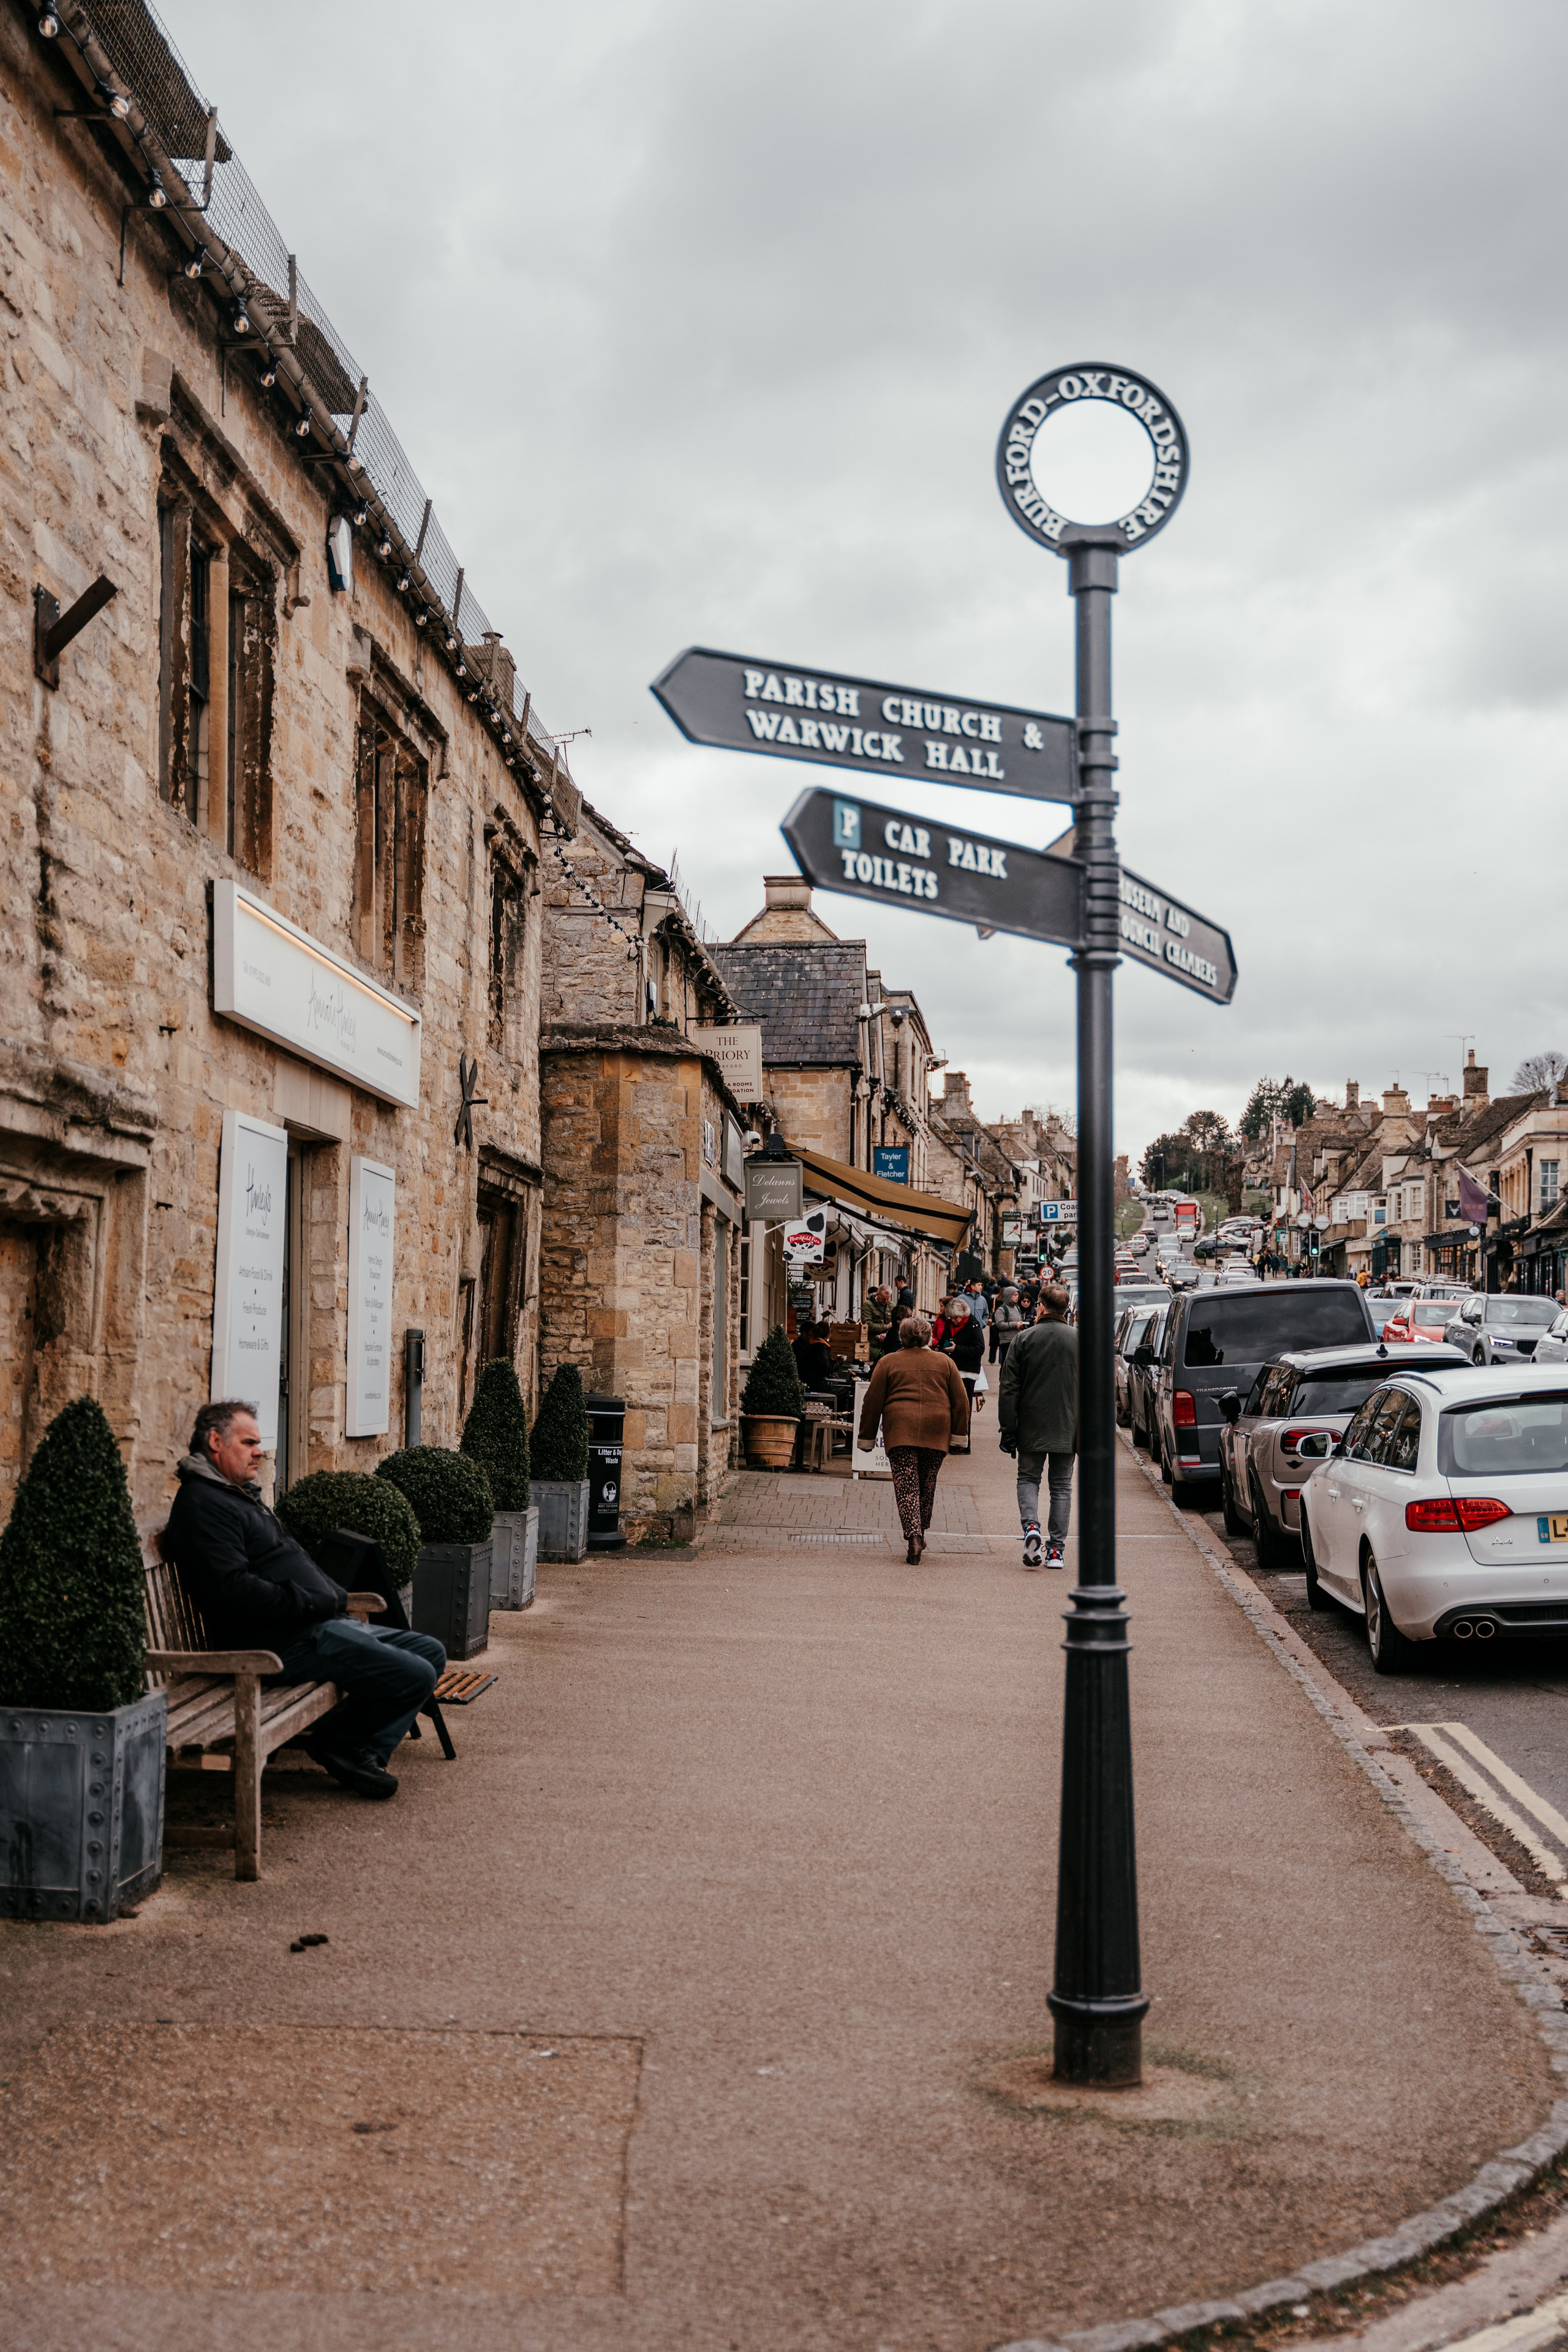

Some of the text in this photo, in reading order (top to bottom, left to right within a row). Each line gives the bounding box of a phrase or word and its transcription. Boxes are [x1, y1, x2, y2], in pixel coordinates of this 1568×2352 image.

[744, 669, 1045, 750] PARISH CHURCH &
[745, 709, 1005, 780] WARWICK HALL
[841, 807, 1008, 880] P CAR PARK
[841, 848, 938, 899] TOILETS
[1167, 907, 1190, 938] AND
[1121, 914, 1218, 986] OUNCIL CHAMBERS
[716, 1036, 739, 1046] THE
[705, 1049, 751, 1061] PRIORY
[880, 1153, 902, 1161] Tayler
[752, 1174, 796, 1186] Delanns
[246, 1162, 271, 1226] Hanley's
[755, 1192, 789, 1209] Jewels
[1046, 1205, 1056, 1218] P
[264, 1269, 273, 1281] Drink
[243, 1302, 266, 1316] Fresh Produce
[239, 1338, 257, 1349] Homeware
[1492, 1536, 1513, 1545] A4
